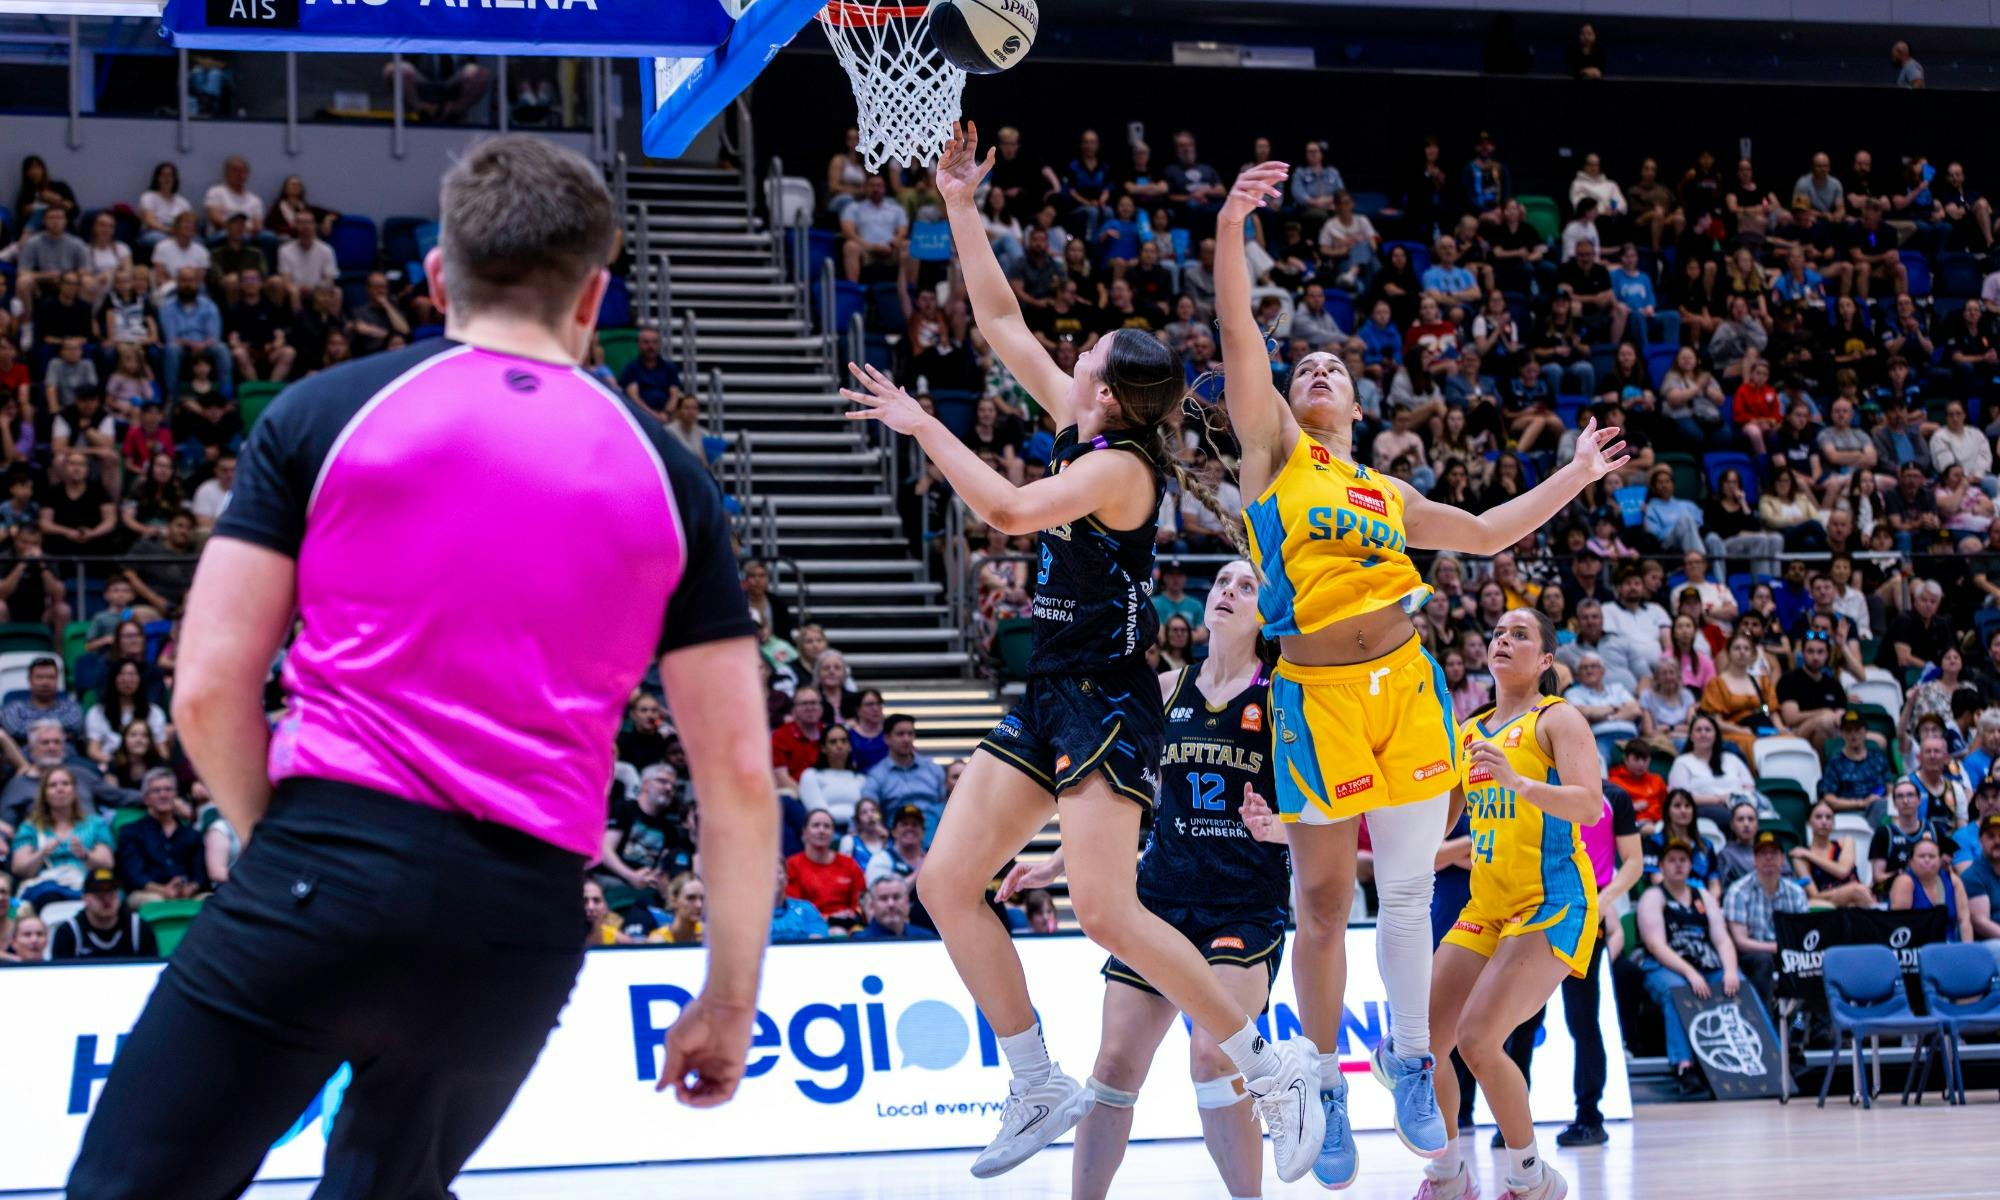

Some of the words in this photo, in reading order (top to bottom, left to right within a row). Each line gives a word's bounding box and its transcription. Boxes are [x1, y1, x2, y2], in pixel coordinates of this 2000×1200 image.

[229, 0, 276, 20] AIS
[1001, 0, 1038, 31] SPALD
[1032, 604, 1074, 623] ANBERRA
[1064, 599, 1076, 609] OF
[1186, 772, 1226, 811] 12
[1781, 948, 1824, 974] SPALD
[876, 1101, 928, 1117] Local
[935, 1102, 1010, 1117] everyw
